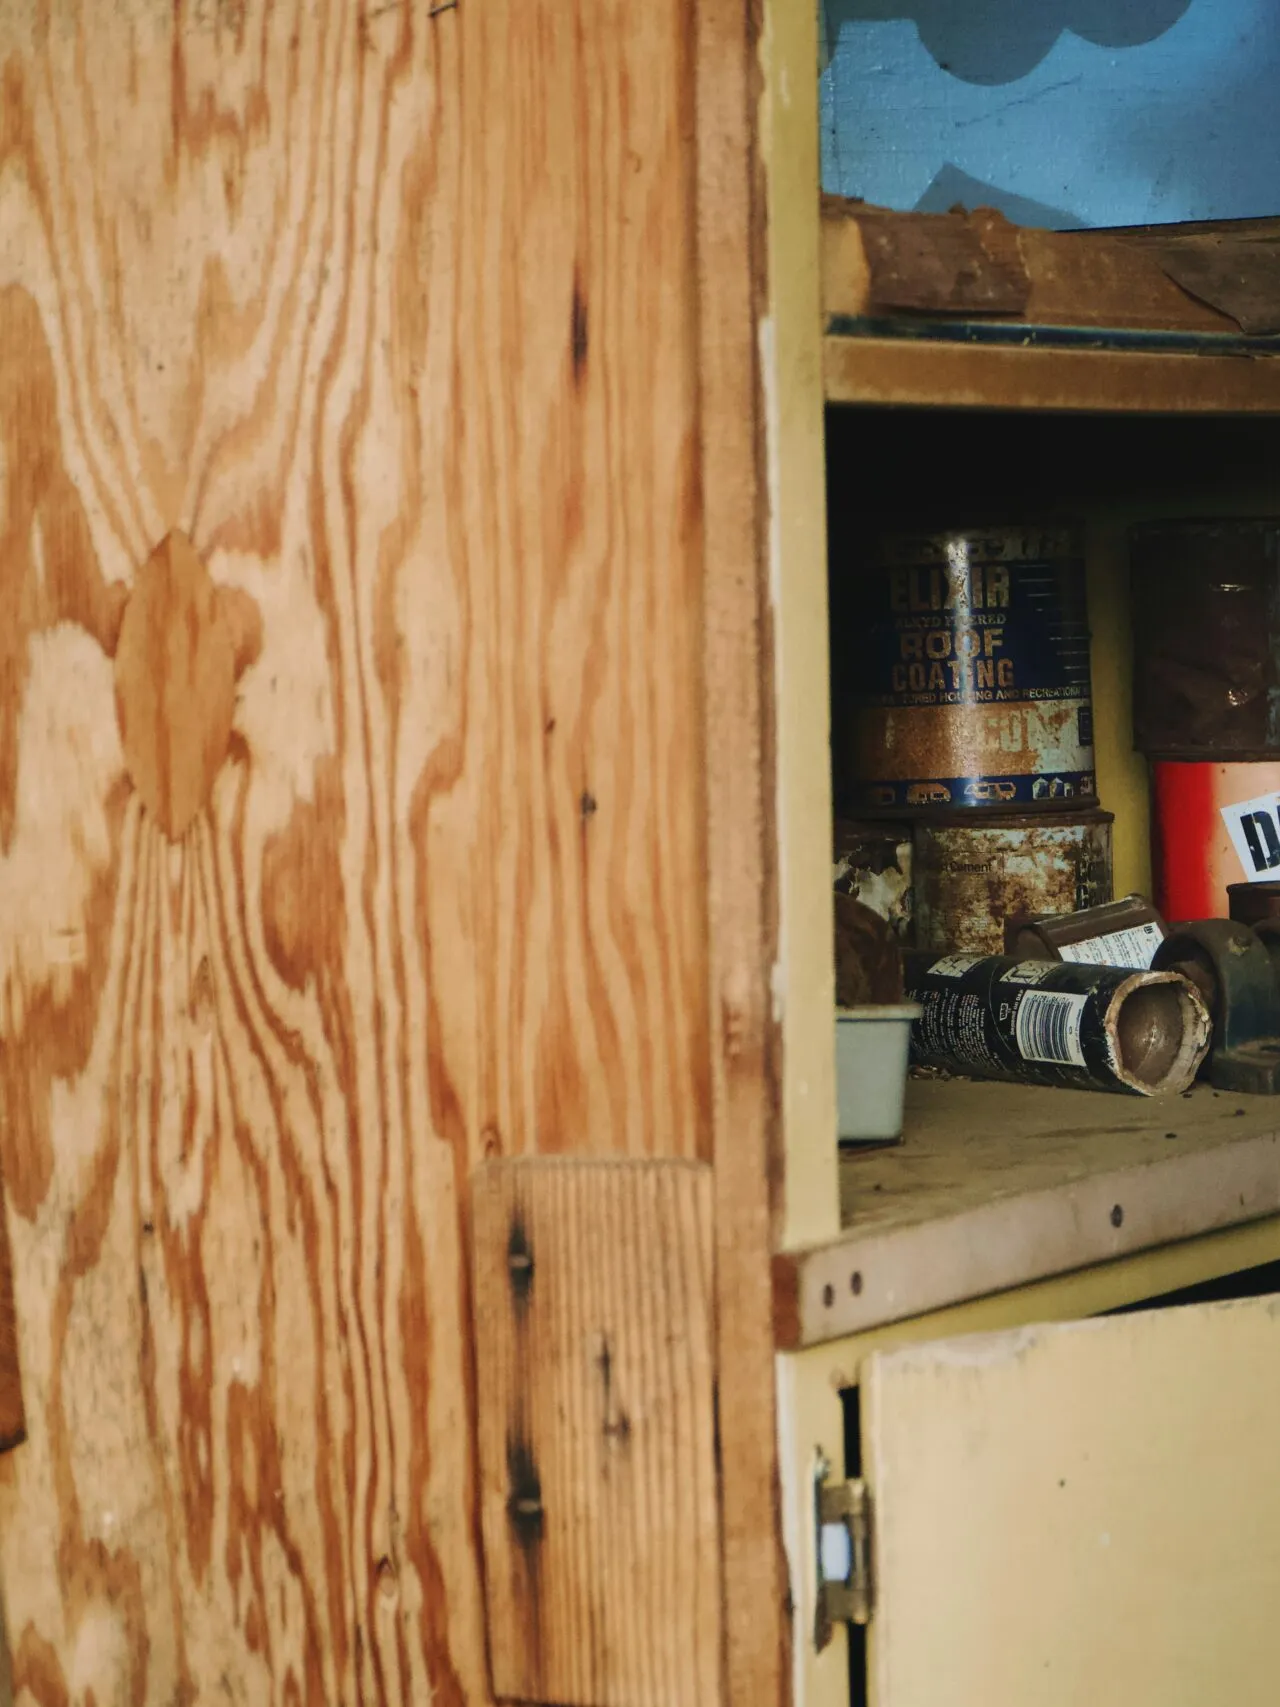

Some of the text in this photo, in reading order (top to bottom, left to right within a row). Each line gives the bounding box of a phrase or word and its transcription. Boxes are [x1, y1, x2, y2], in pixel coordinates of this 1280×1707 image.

[890, 564, 1010, 611] ELIXIR
[901, 628, 1004, 661] ROOF
[891, 658, 1015, 691] COATING
[949, 860, 993, 873] Cement
